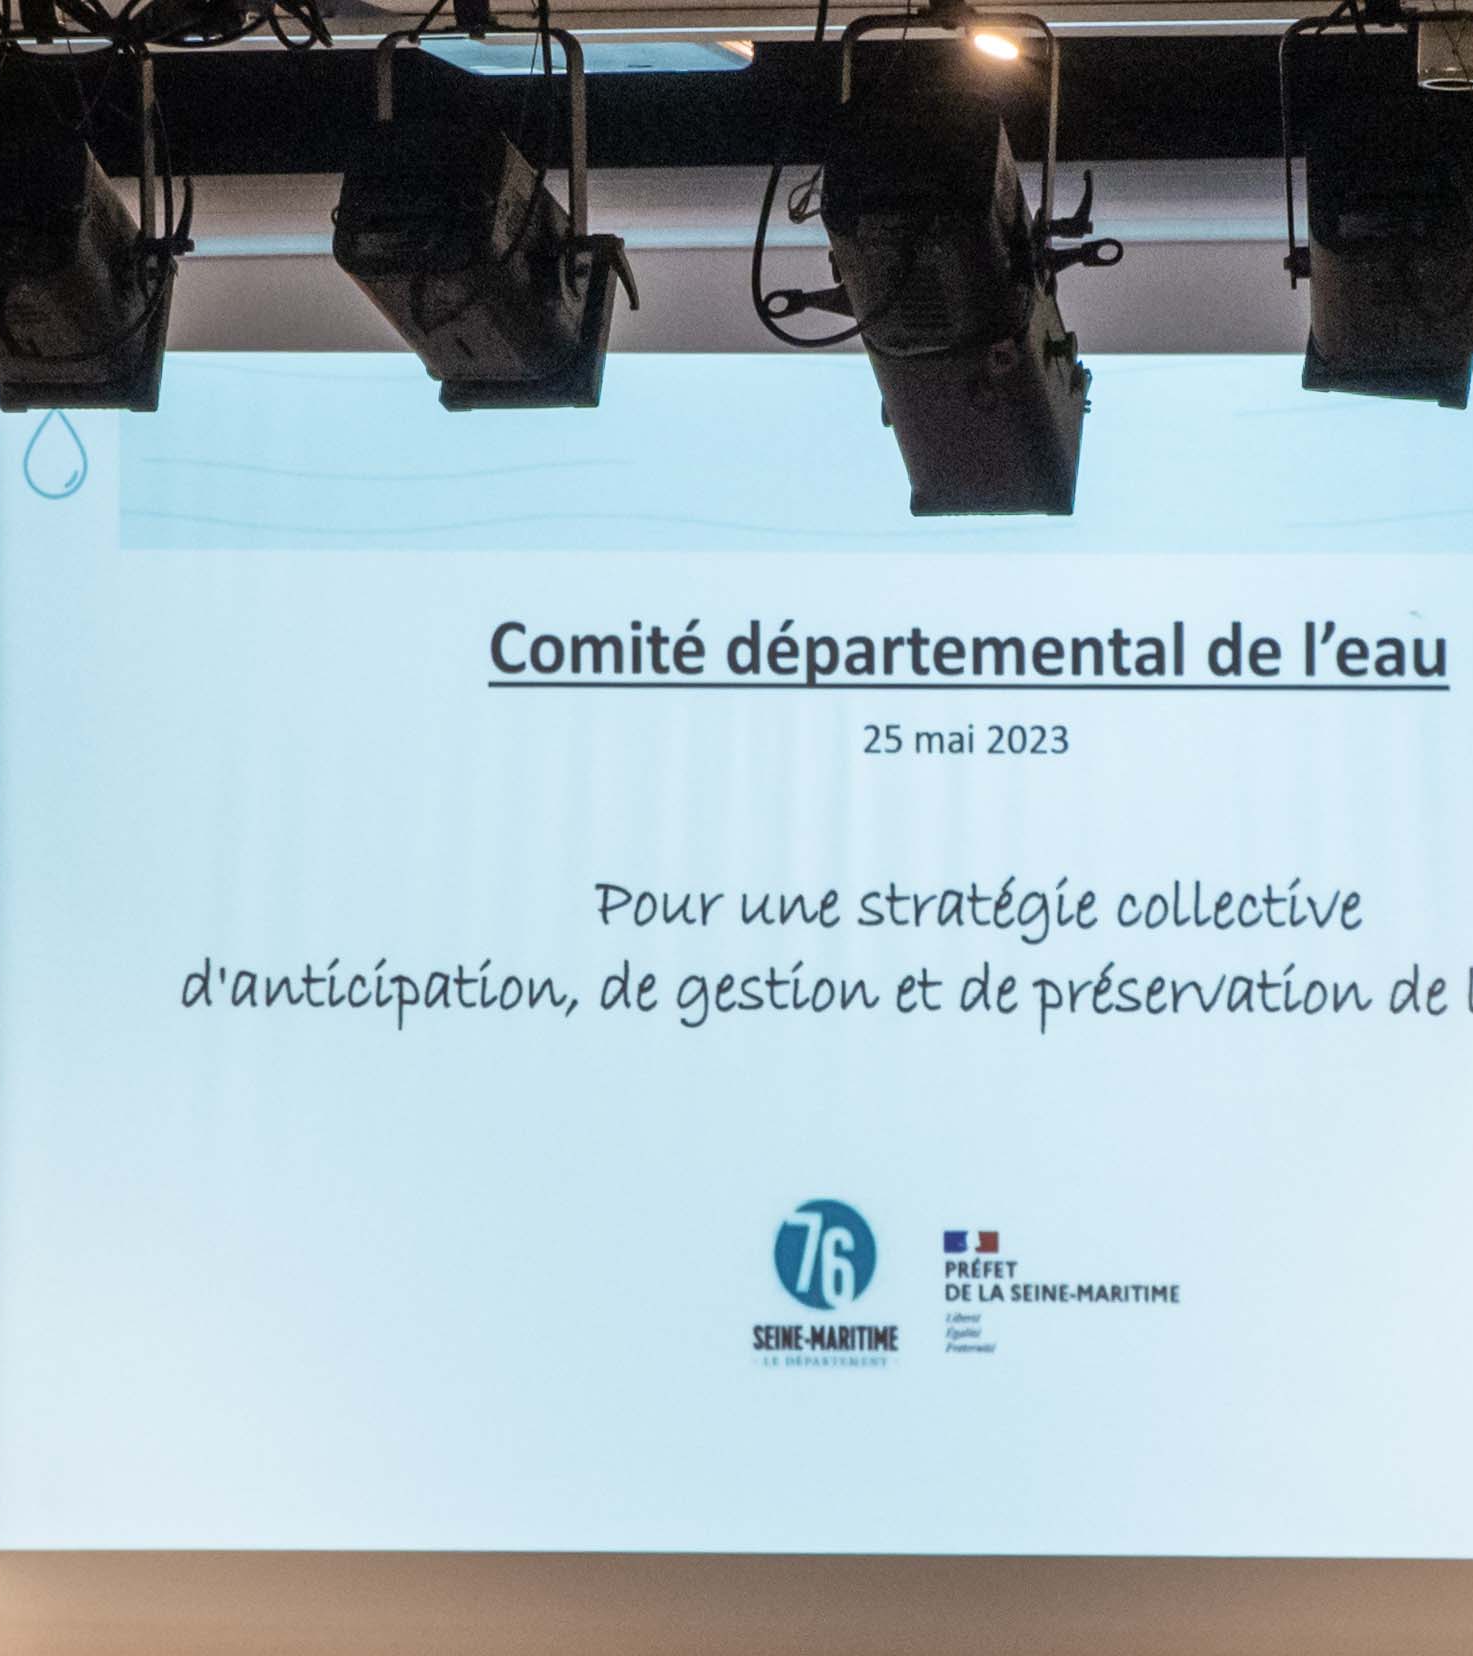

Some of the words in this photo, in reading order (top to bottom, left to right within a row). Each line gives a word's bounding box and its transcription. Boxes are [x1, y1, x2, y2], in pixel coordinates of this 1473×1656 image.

[490, 618, 707, 679] Comité
[726, 618, 1185, 690] départemental
[1207, 621, 1282, 680] de
[1305, 620, 1449, 681] l'eau
[863, 724, 903, 754] 25
[915, 723, 974, 754] mai
[987, 724, 1069, 755] 2023
[594, 882, 725, 927] Pour
[741, 888, 841, 929] une
[857, 875, 1098, 946] stratégie
[1117, 877, 1363, 931] collective
[180, 956, 580, 1034] d'anticipation,
[599, 959, 659, 1013] de
[675, 959, 881, 1033] gestion
[895, 967, 943, 1014] et
[959, 960, 1019, 1015] de
[1031, 960, 1373, 1035] préservation
[1388, 962, 1449, 1017] de
[782, 1211, 856, 1308] 76
[944, 1257, 1018, 1279] PRÉFET
[944, 1283, 972, 1302] DE
[978, 1283, 1005, 1303] LA
[1010, 1283, 1181, 1304] SEINE-MARITIME
[753, 1324, 899, 1352] SEINE-MARITIME
